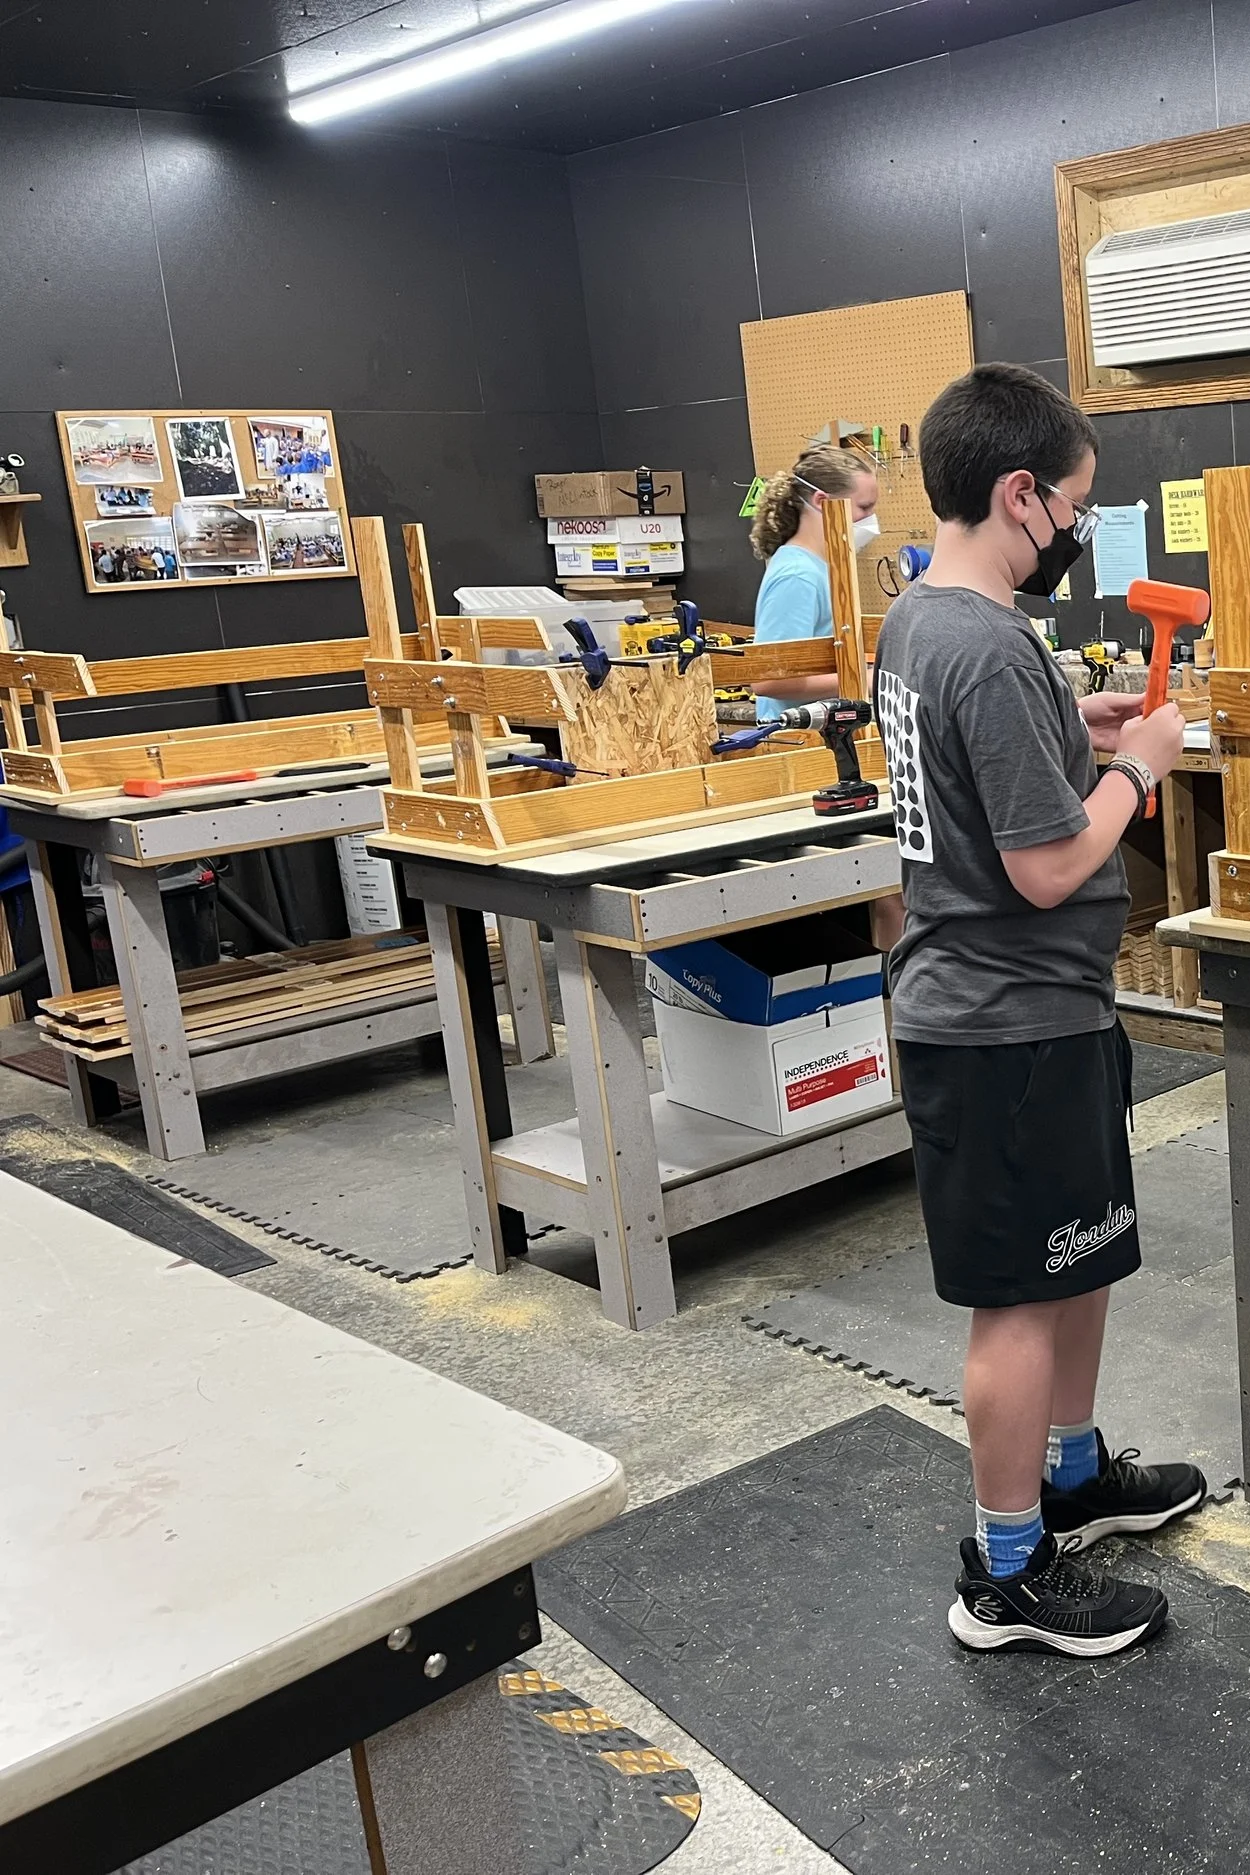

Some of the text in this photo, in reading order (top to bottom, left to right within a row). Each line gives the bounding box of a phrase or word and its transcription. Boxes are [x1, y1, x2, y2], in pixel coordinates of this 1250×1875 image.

[641, 523, 662, 534] U20
[648, 972, 659, 992] 10
[683, 968, 705, 993] Copy
[703, 983, 723, 1004] Plus
[784, 1049, 850, 1079] INDEPENDENCE
[787, 1077, 828, 1097] Multi Purpose
[1045, 1200, 1135, 1273] Jordan
